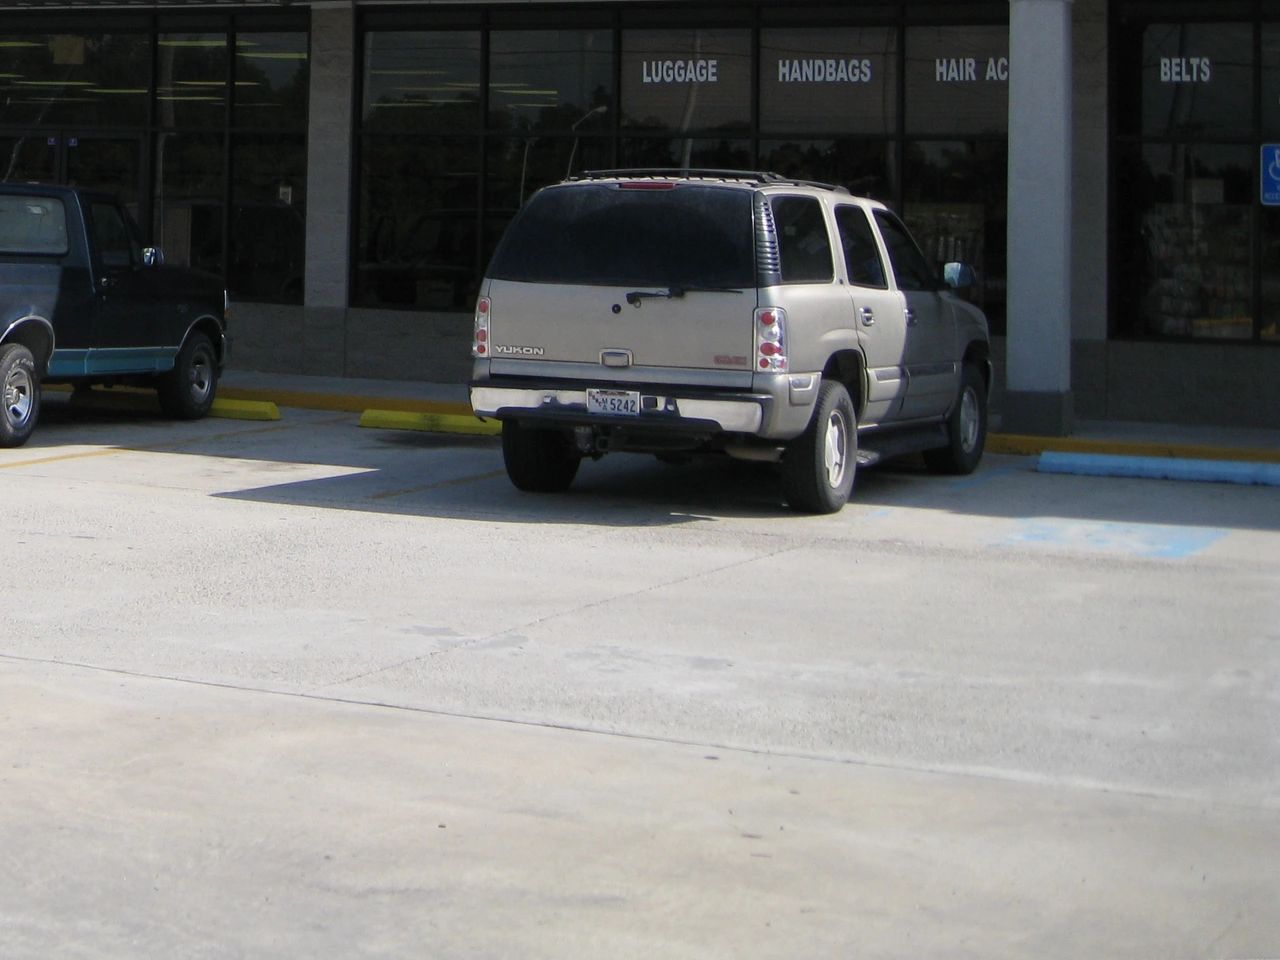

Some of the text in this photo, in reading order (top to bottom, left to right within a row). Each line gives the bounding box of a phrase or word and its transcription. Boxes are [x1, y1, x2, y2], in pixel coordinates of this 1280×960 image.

[642, 60, 718, 83] LUGGAGE
[778, 59, 871, 82] HANDBAGS
[935, 58, 977, 82] HAIR
[1160, 57, 1211, 82] BELTS
[495, 345, 544, 355] YUKON
[610, 398, 636, 413] 5242
